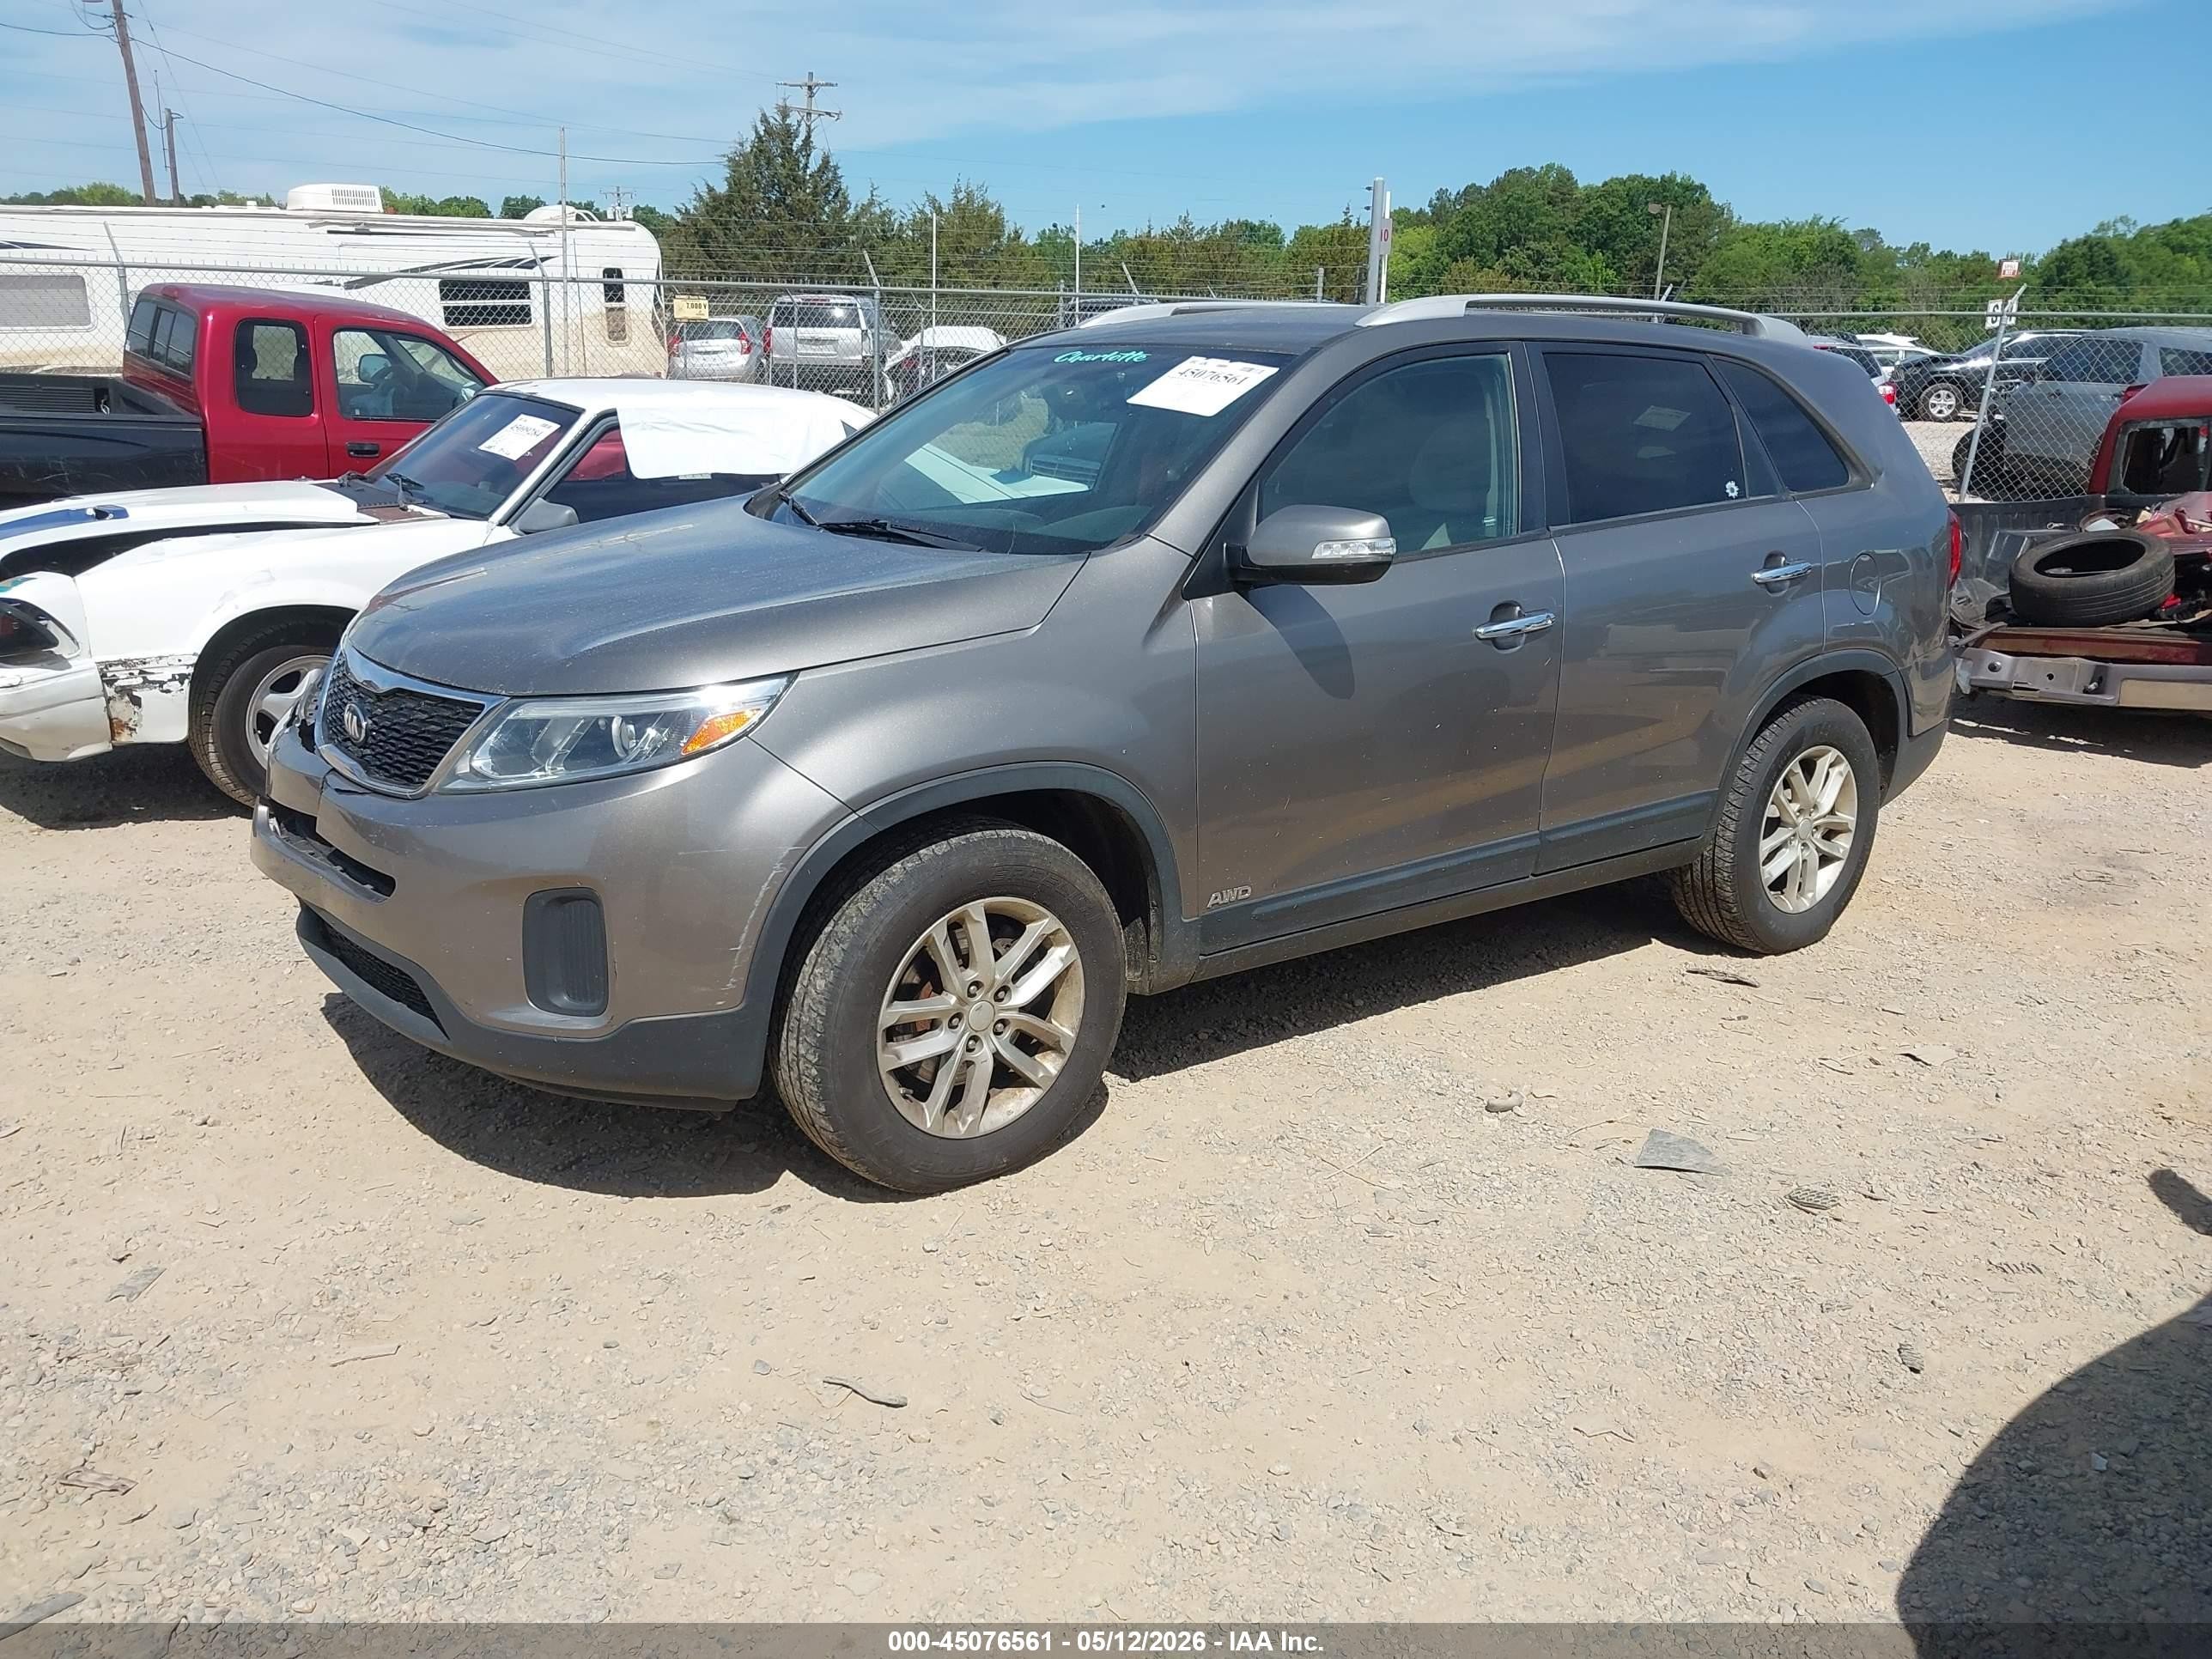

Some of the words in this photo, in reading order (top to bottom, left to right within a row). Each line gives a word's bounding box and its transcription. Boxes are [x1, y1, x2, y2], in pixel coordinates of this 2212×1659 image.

[1054, 350, 1152, 363] Charlotte
[1178, 368, 1250, 386] 45076561
[1206, 885, 1252, 908] AWD
